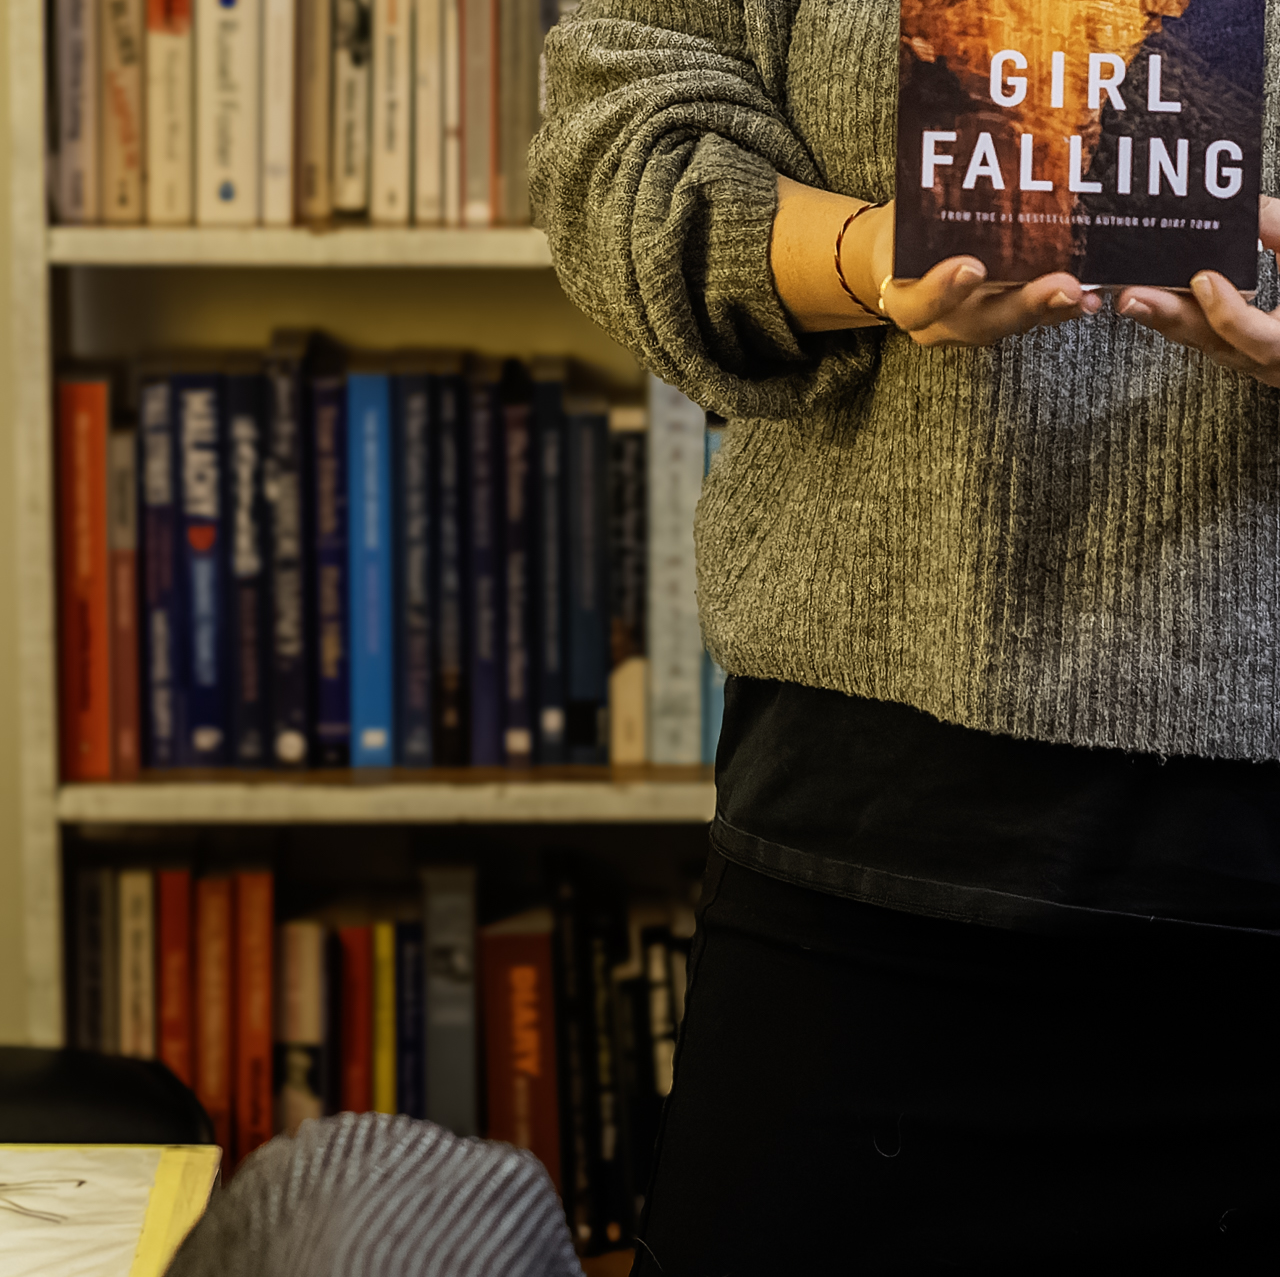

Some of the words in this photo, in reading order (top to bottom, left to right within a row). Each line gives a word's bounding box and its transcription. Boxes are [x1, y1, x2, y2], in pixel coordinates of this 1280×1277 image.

[989, 49, 1181, 113] GIRL
[920, 130, 1243, 199] FALLING
[940, 211, 971, 221] FROM
[976, 211, 995, 222] THE
[1017, 212, 1091, 225] BESTSELLING
[1095, 215, 1138, 227] AUTHOR
[1142, 216, 1155, 227] OF
[1189, 218, 1219, 230] TOWN
